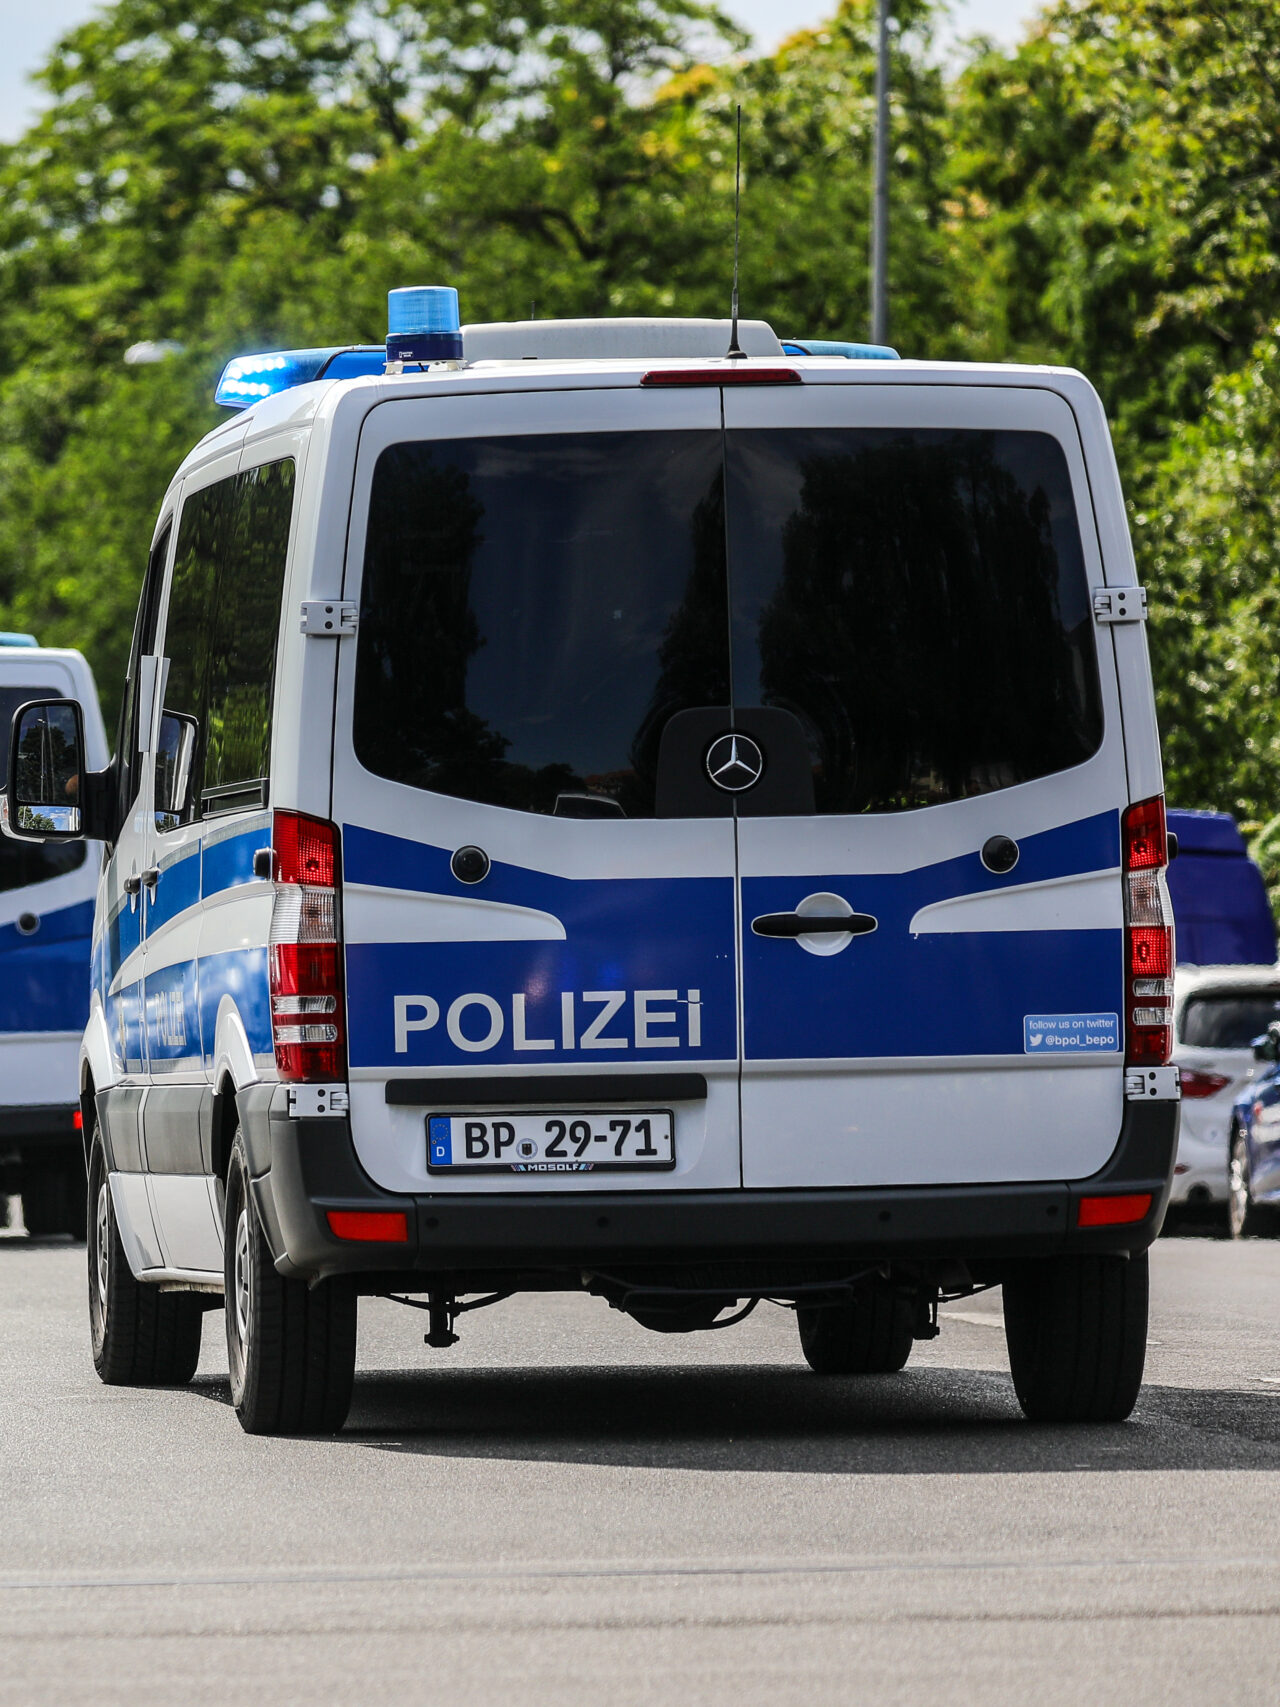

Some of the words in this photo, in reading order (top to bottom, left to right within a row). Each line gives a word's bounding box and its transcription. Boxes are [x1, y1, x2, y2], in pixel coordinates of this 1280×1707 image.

[1029, 1020, 1057, 1029] follow
[1058, 1020, 1070, 1029] us
[1072, 1020, 1085, 1028] on
[1086, 1019, 1114, 1028] twitter
[1045, 1035, 1114, 1047] @bpol_bepo
[464, 1121, 516, 1159] BP
[544, 1118, 658, 1158] 29-71
[436, 1146, 445, 1157] D
[527, 1163, 579, 1171] MOSOLF
